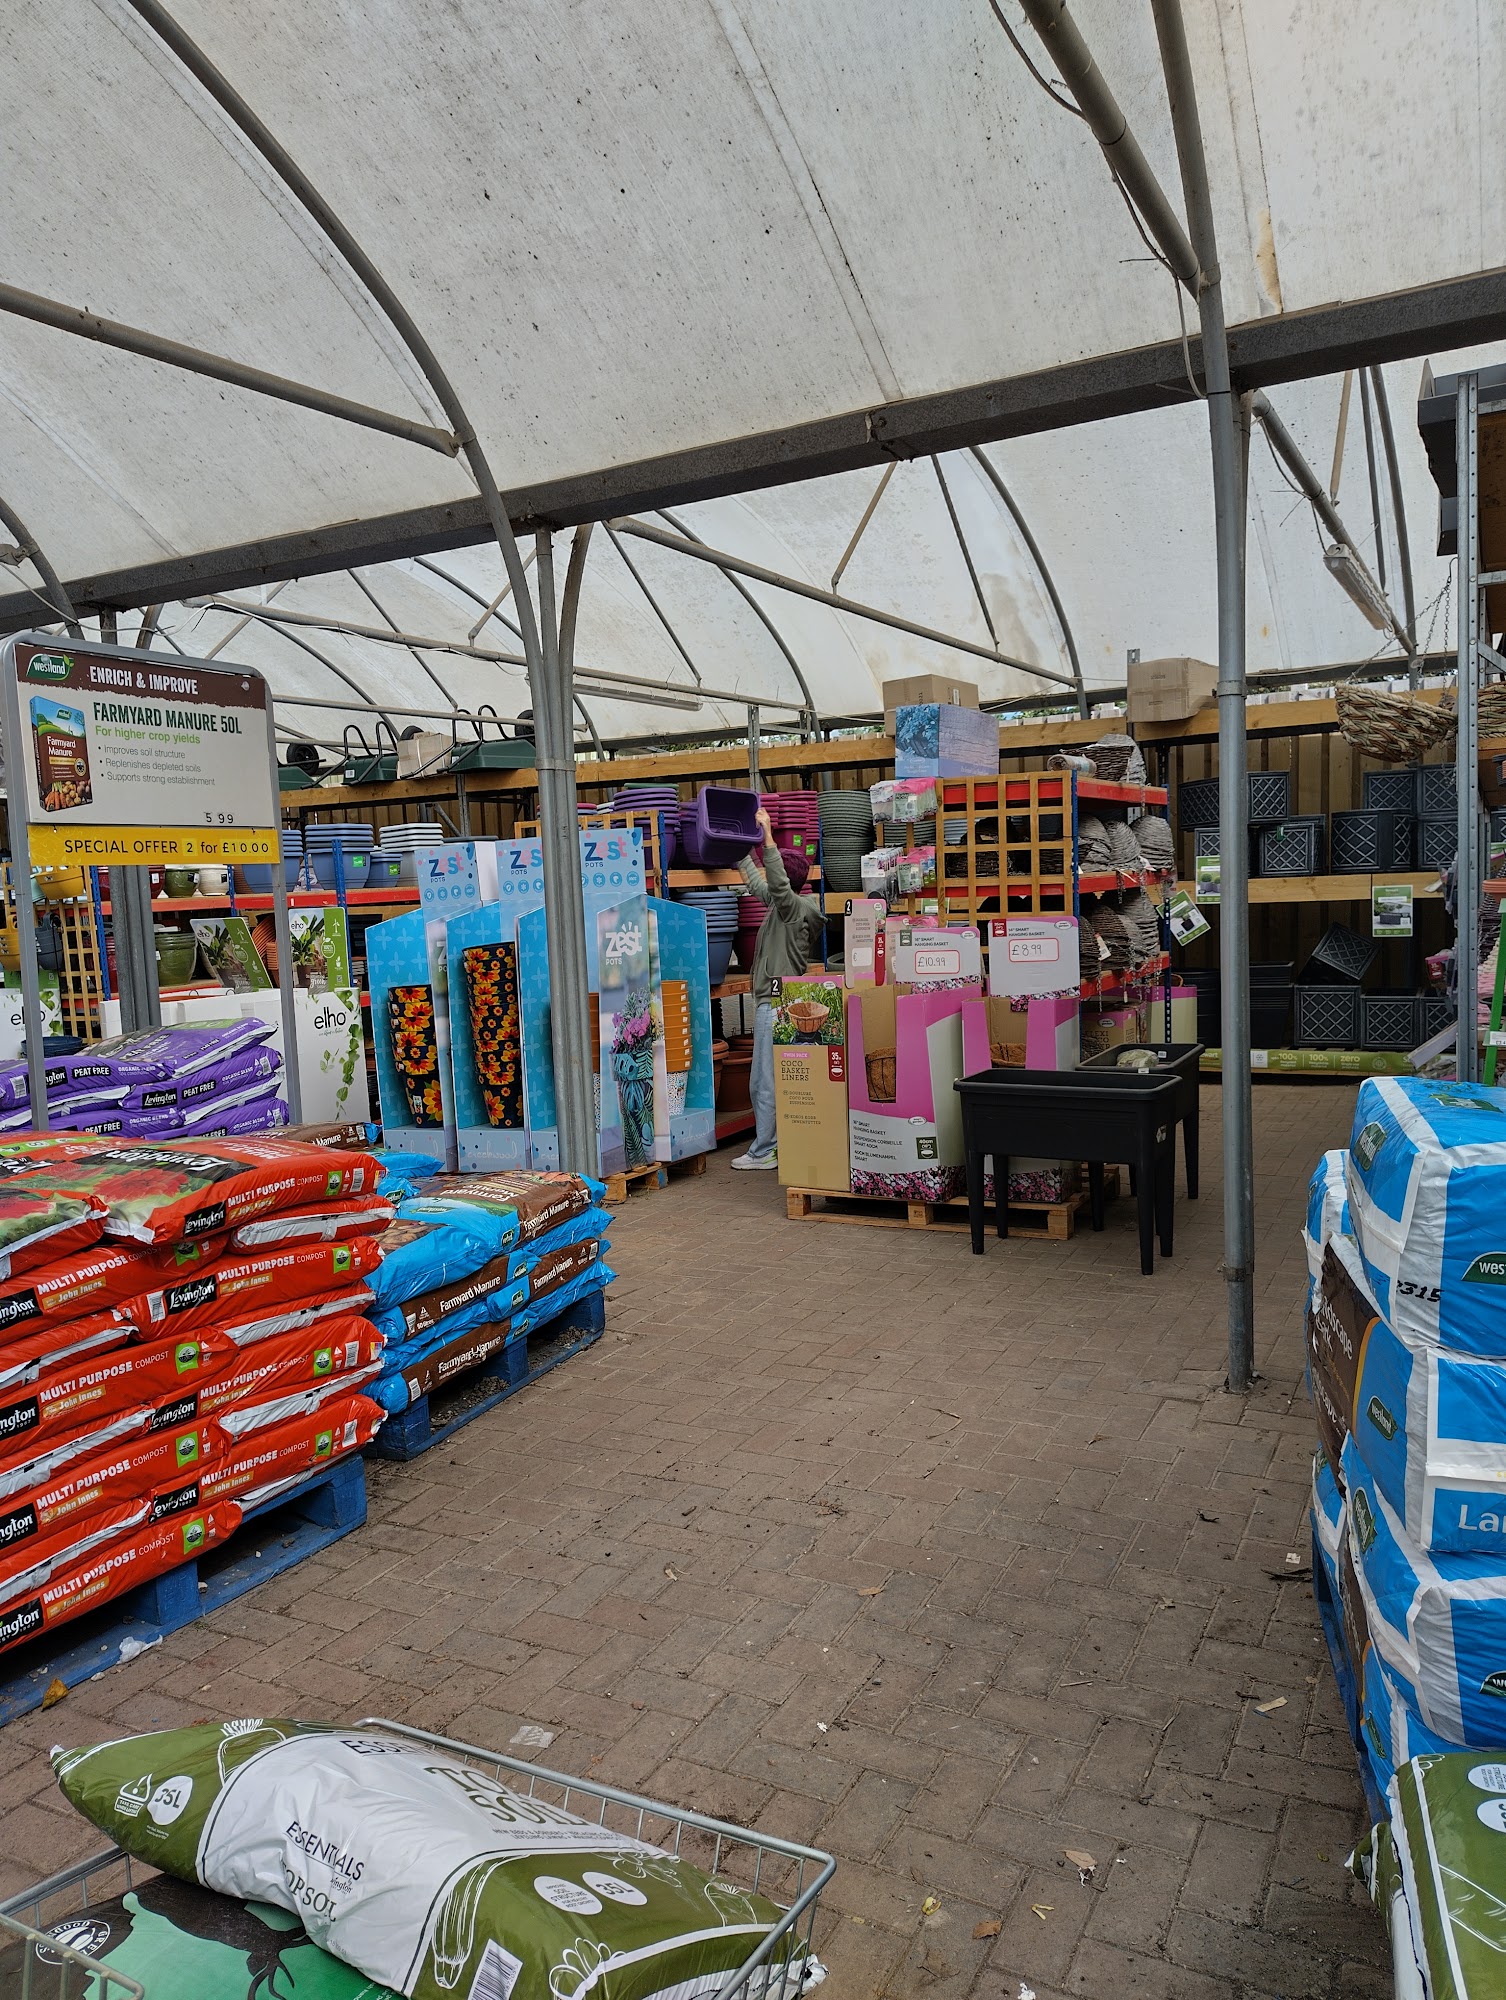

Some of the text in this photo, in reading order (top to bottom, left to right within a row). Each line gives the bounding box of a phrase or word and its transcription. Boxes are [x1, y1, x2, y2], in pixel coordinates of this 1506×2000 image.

[33, 661, 66, 675] westland
[89, 666, 198, 695] ENRICH & IMPROVE
[93, 702, 242, 734] FARMYARD MANURE 50L
[47, 735, 77, 749] Farmyard
[95, 726, 200, 745] For higher crop yields
[48, 746, 73, 757] Manure
[104, 744, 185, 759] Improves soil structure
[106, 758, 201, 773] Replenishes depleted soils
[107, 772, 215, 786] Supports strong establishment
[64, 840, 129, 854] SPECIAL
[133, 841, 179, 853] OFFER
[186, 843, 193, 853] 2
[200, 841, 218, 854] for
[510, 848, 544, 870] zes
[605, 957, 623, 966] POTS
[917, 956, 946, 967] £10.99
[772, 979, 779, 992] 2
[10, 1005, 46, 1026] elo
[314, 1006, 346, 1030] elho
[45, 1071, 66, 1085] ngton
[73, 1067, 92, 1078] PEAT
[92, 1066, 110, 1076] FREE
[781, 1067, 810, 1075] BASKET
[781, 1074, 809, 1082] LINERS
[144, 1091, 177, 1106] Levington
[183, 1081, 215, 1098] PEAT FREE
[85, 1121, 121, 1133] PEAT FREE
[129, 1116, 151, 1124] ORGANIC
[319, 1133, 342, 1147] Manure
[853, 1135, 877, 1143] SUSPENSION
[866, 1151, 897, 1160] BLUMENAMPEL
[228, 1174, 324, 1207] MULTI PURPOSE COMPOST
[440, 1188, 513, 1203] Farmyard
[462, 1183, 519, 1199] Manure
[549, 1200, 570, 1217] Manure
[37, 1274, 77, 1296] MULTI
[78, 1255, 128, 1281] PURPOSE
[218, 1250, 327, 1282] MULTI PURPOSE COMPOST
[533, 1268, 557, 1290] Farmyard
[556, 1257, 574, 1274] Manure
[58, 1279, 103, 1304] John Innes
[231, 1274, 270, 1292] John Innes
[169, 1279, 214, 1310] Levington
[440, 1276, 501, 1313] Farmyard Manure
[1320, 1296, 1354, 1361] ndscape
[438, 1346, 474, 1374] Farmyard
[474, 1335, 501, 1356] Manure
[40, 1350, 169, 1403] MULTI PURPOSE COMPOST
[200, 1380, 232, 1399] MULTI
[233, 1361, 277, 1386] PURPOSE
[59, 1387, 102, 1410] John Innes
[0, 1405, 36, 1432] ngton
[1371, 1402, 1394, 1435] westland
[201, 1439, 310, 1487] MULTI PURPOSE COMPOST
[36, 1444, 169, 1510] MULTI PURPOSE COMPOST
[213, 1473, 250, 1494] John Innes
[56, 1489, 99, 1516] John Innes
[0, 1513, 33, 1541] ngton
[43, 1532, 175, 1604] MULTI PURPOSE COMPOST
[82, 1580, 106, 1598] Innes
[0, 1611, 40, 1640] ington
[469, 1794, 590, 1826] SOIL
[285, 1820, 365, 1881] ESSENTIALS
[550, 1890, 588, 1903] STRUCTURE
[595, 1881, 635, 1895] 35L
